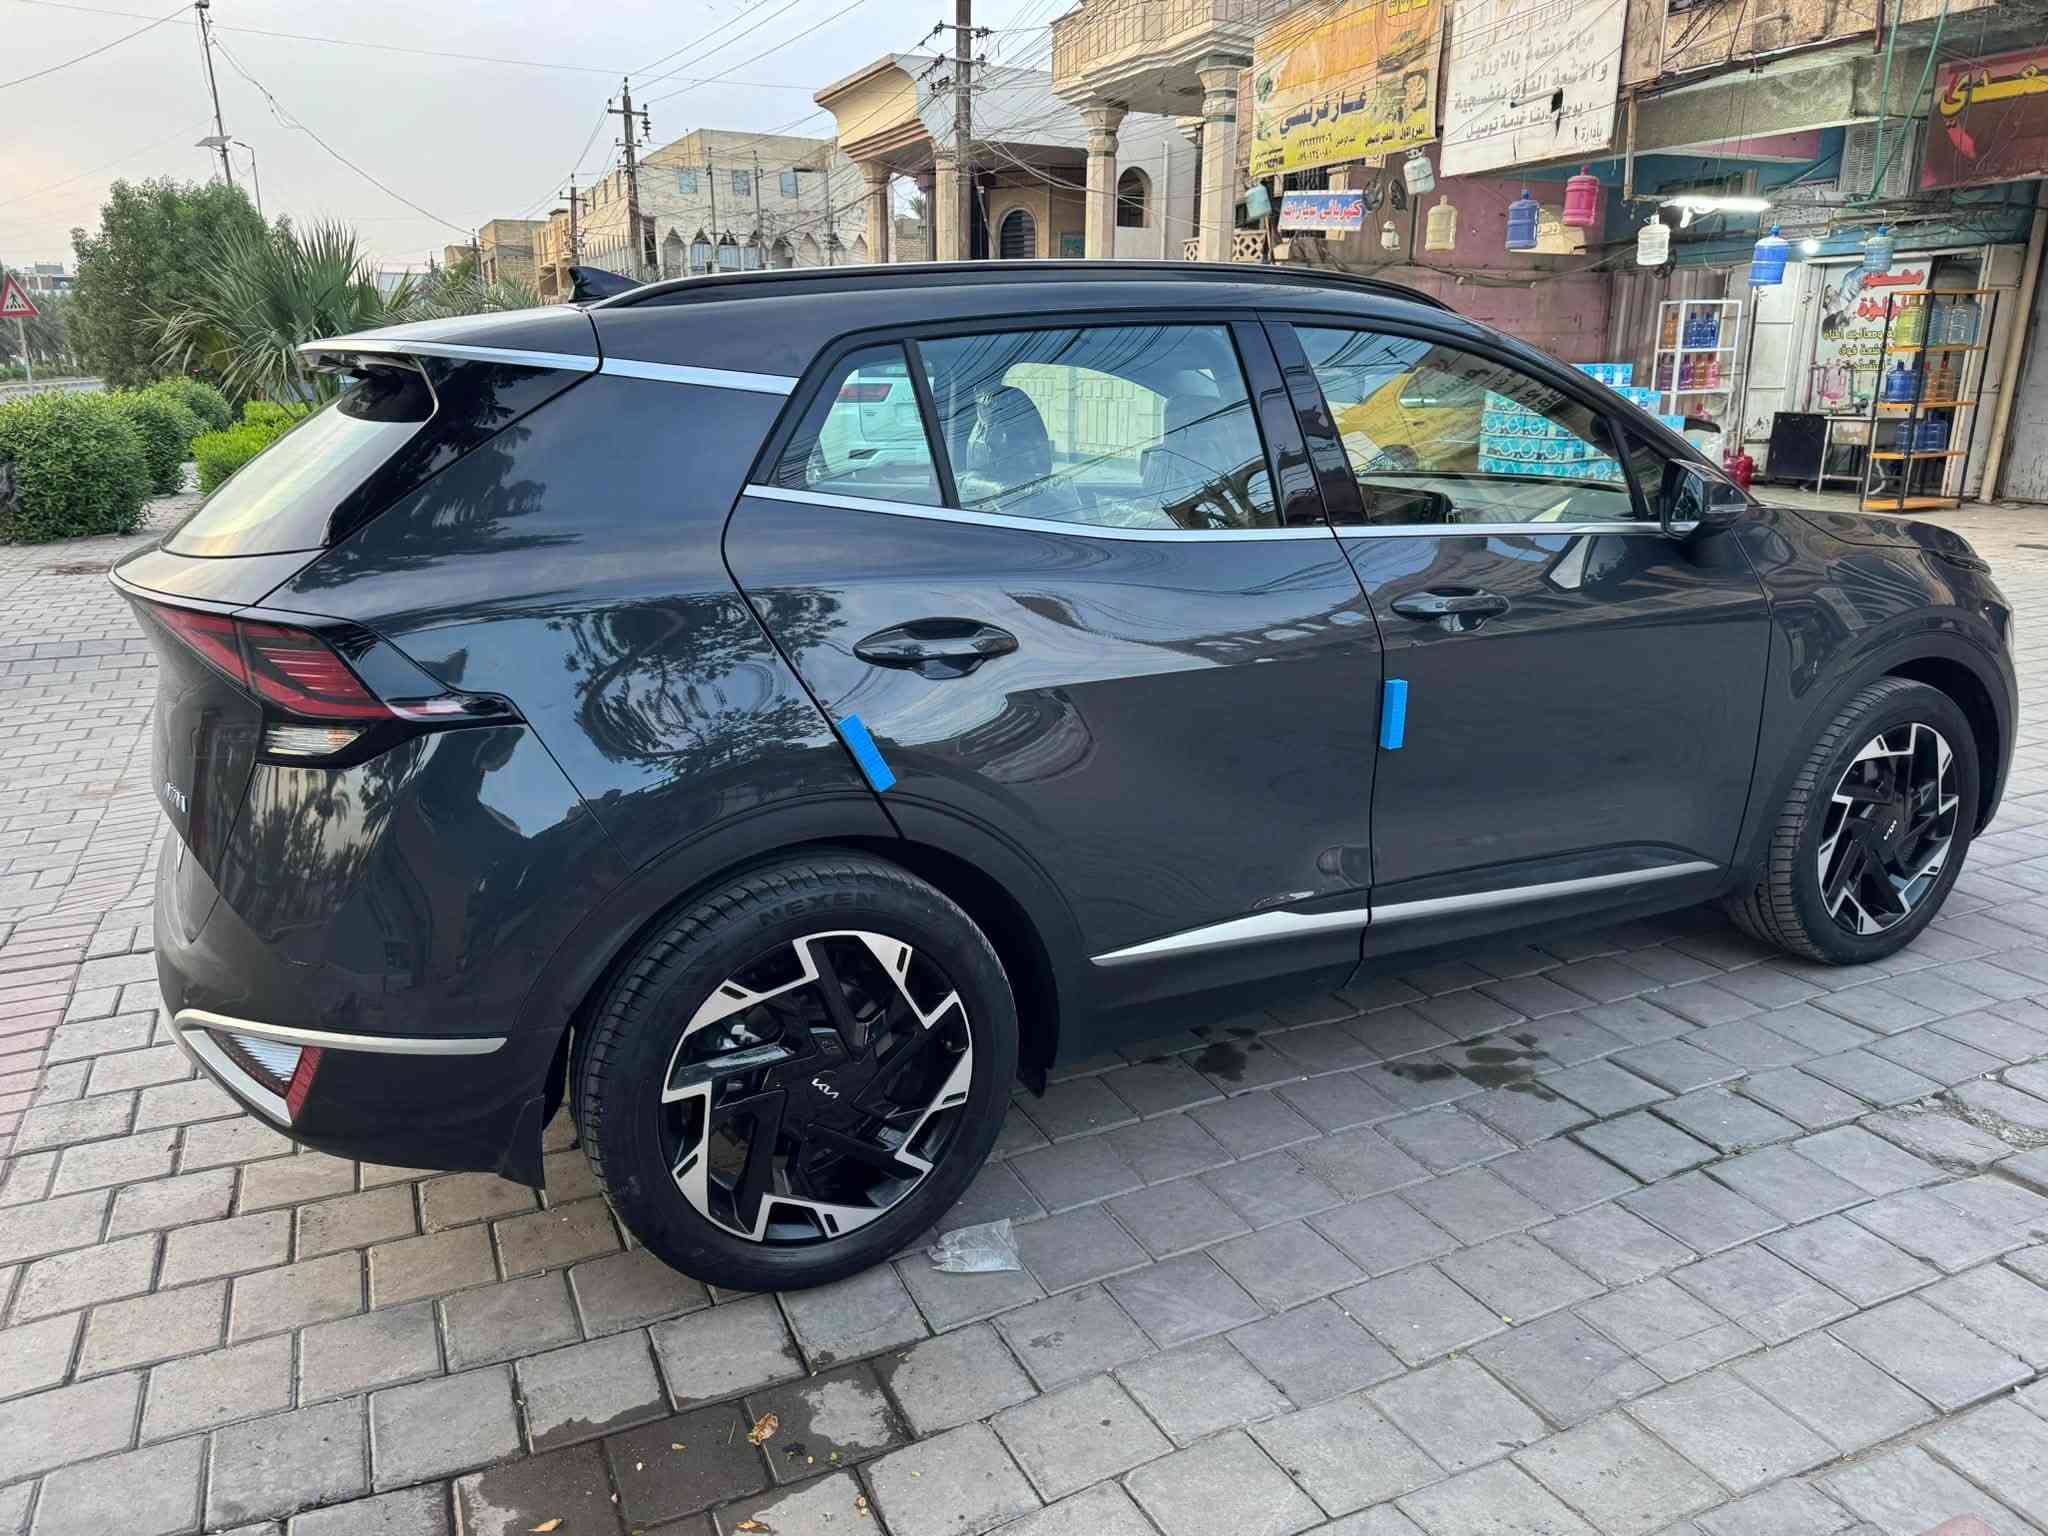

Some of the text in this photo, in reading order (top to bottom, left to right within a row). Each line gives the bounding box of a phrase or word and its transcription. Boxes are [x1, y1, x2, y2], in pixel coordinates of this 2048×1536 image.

[1279, 94, 1329, 140] فرنسي
[1328, 85, 1368, 122] غاز
[1283, 199, 1363, 221] كهربائي سيارات
[757, 890, 880, 927] NEXEN
